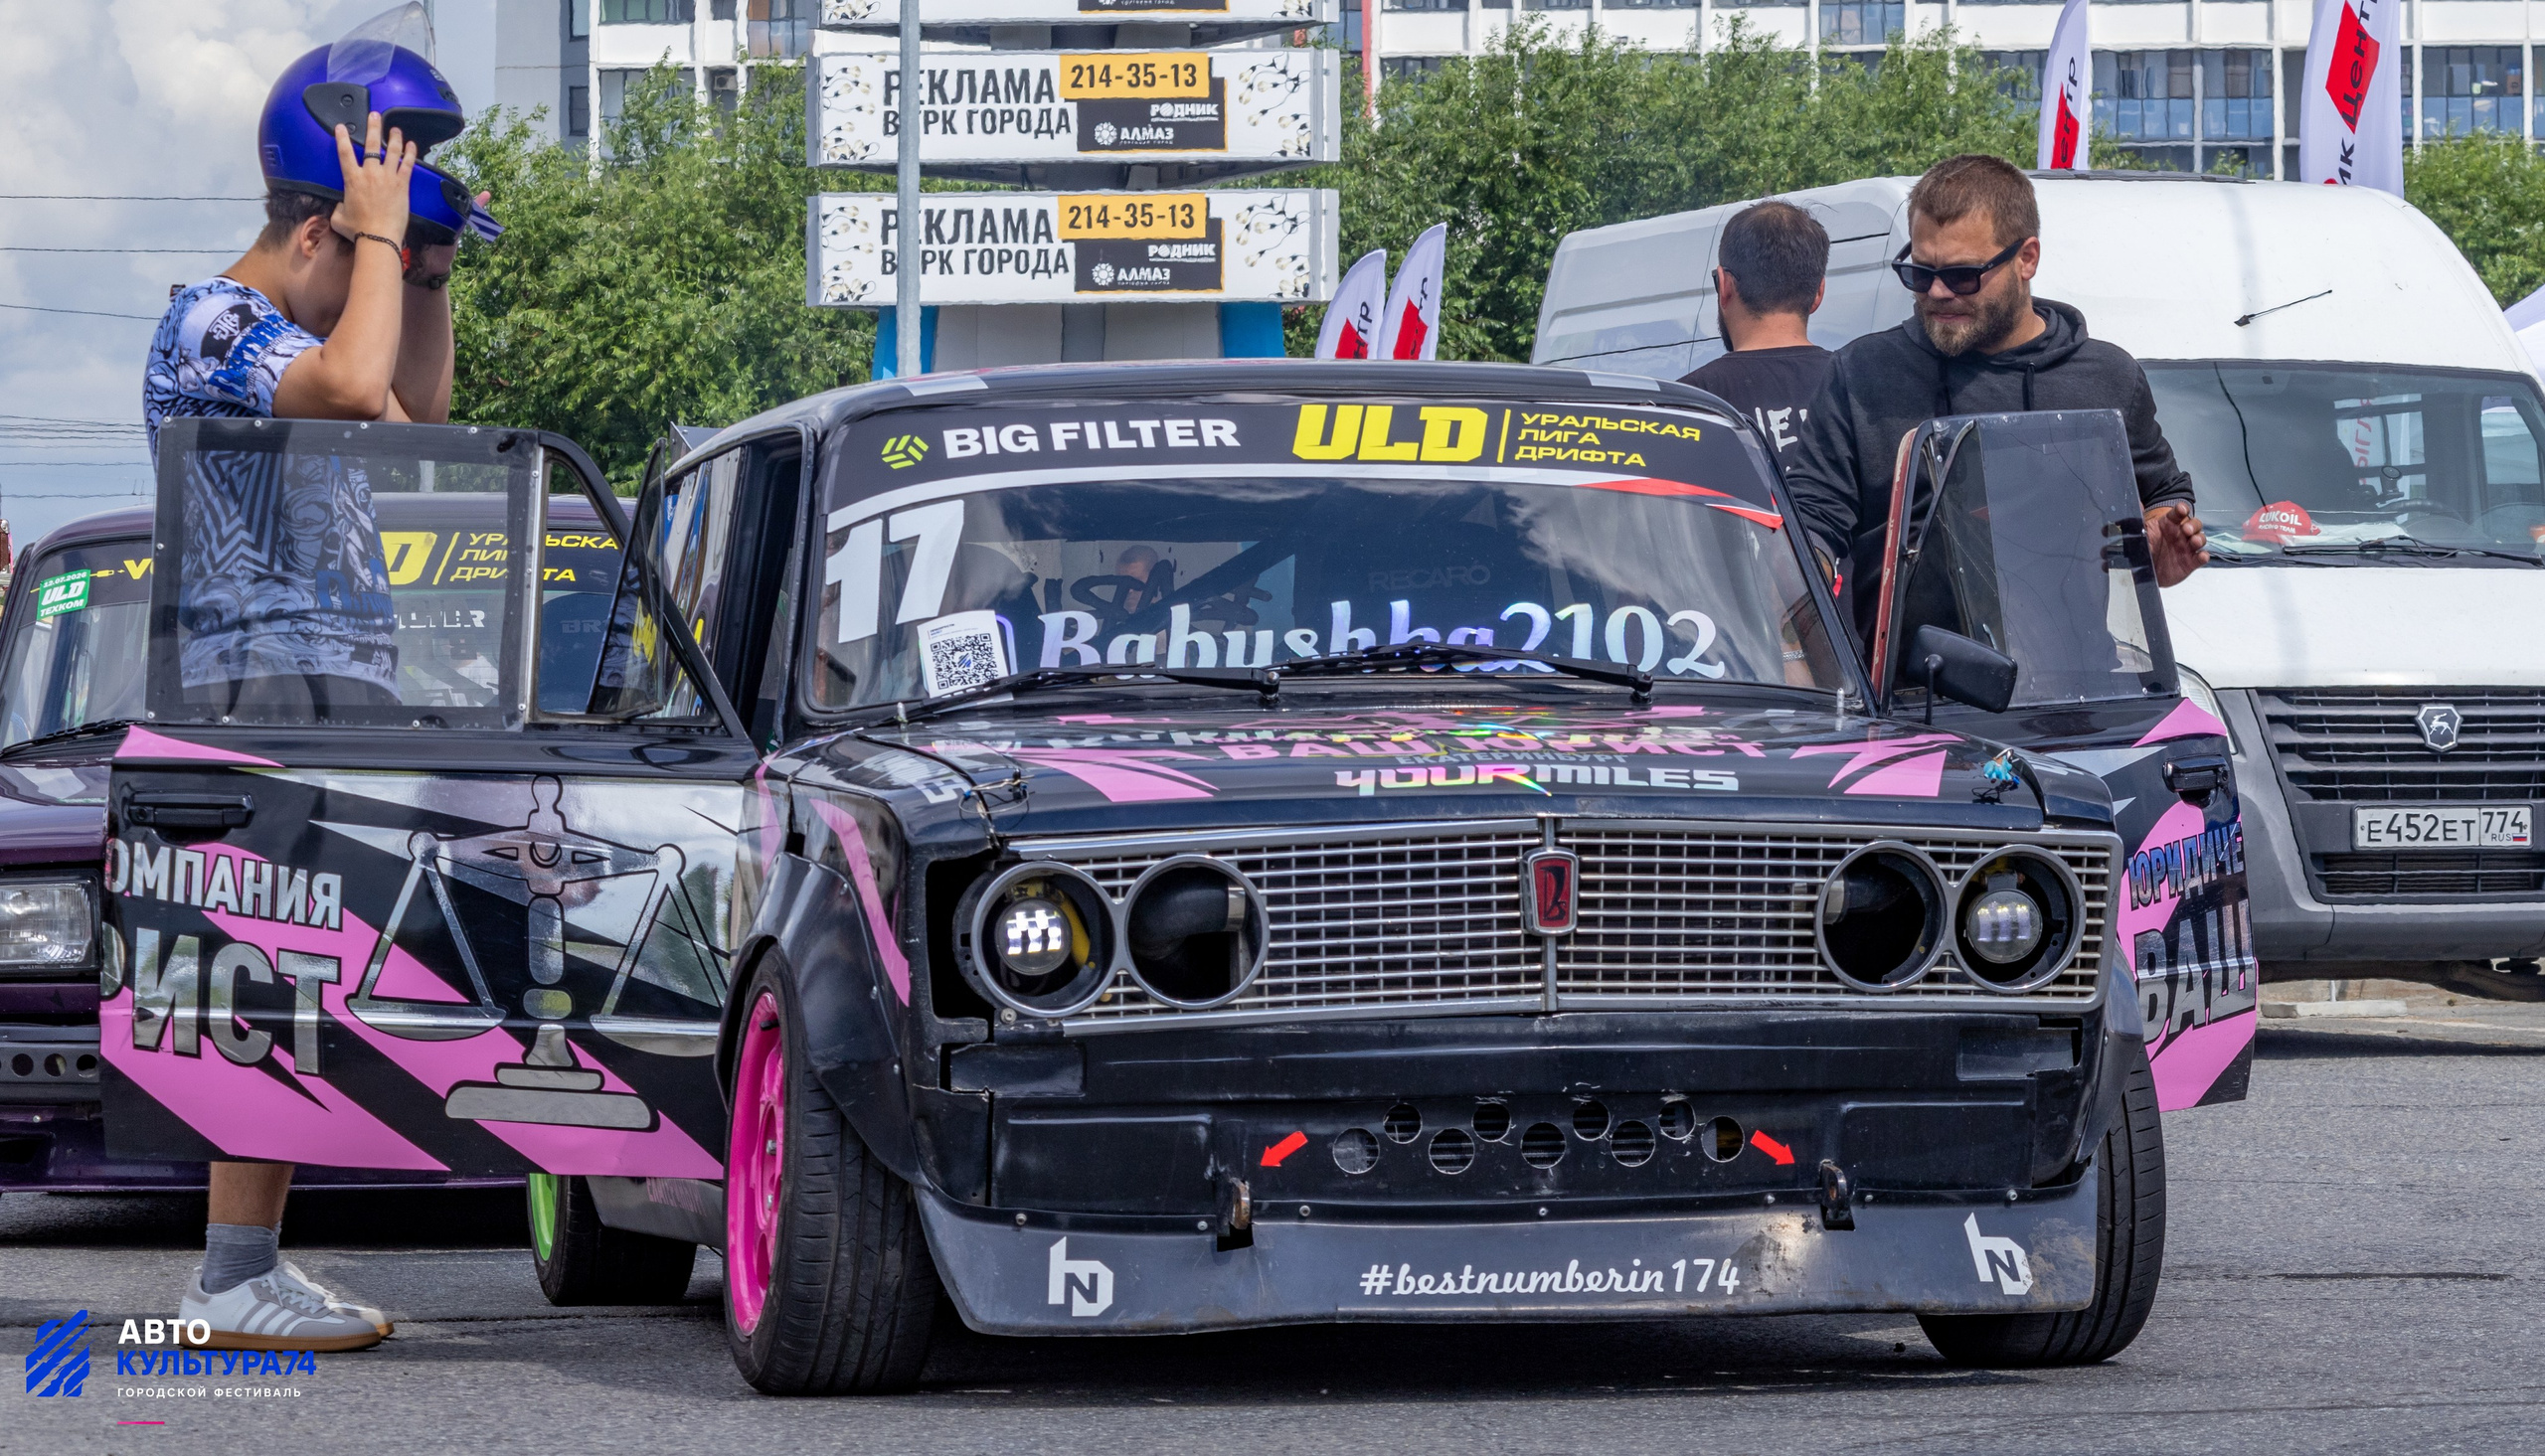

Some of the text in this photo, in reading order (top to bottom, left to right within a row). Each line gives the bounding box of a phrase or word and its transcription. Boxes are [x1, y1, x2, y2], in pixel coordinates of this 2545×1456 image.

[1071, 63, 1197, 88] 214-35-13
[2341, 0, 2377, 126] Цент
[883, 68, 1056, 106] РКЛАМА
[1150, 102, 1220, 117] РОДНИК
[918, 108, 958, 135] РК
[966, 107, 1072, 140] ГОРОДА
[1119, 126, 1175, 140] АЛМАЗ
[880, 207, 1054, 245] РКЛАМА
[1068, 203, 1195, 230] 214-35-13
[1147, 243, 1217, 258] РОДНИК
[963, 247, 1070, 280] ГОРОДА
[1116, 267, 1171, 281] АЛМАЗ
[942, 418, 1242, 459] BIG FILTER
[1292, 404, 1488, 463] ULD
[1517, 428, 1602, 446] ЛИГА
[1520, 411, 1701, 441] УРАЛЬСКАЯ
[1514, 445, 1647, 468] ДРИФТА
[2258, 510, 2302, 527] LUKOIL
[2279, 525, 2296, 534] TEAM
[825, 499, 964, 645] 17
[1368, 565, 1491, 592] RECARO
[41, 580, 86, 606] ULD
[40, 598, 85, 617] ТЕХКОМ
[1219, 739, 1438, 760] ВАШ
[2481, 810, 2524, 834] 774
[2490, 833, 2512, 843] RUS
